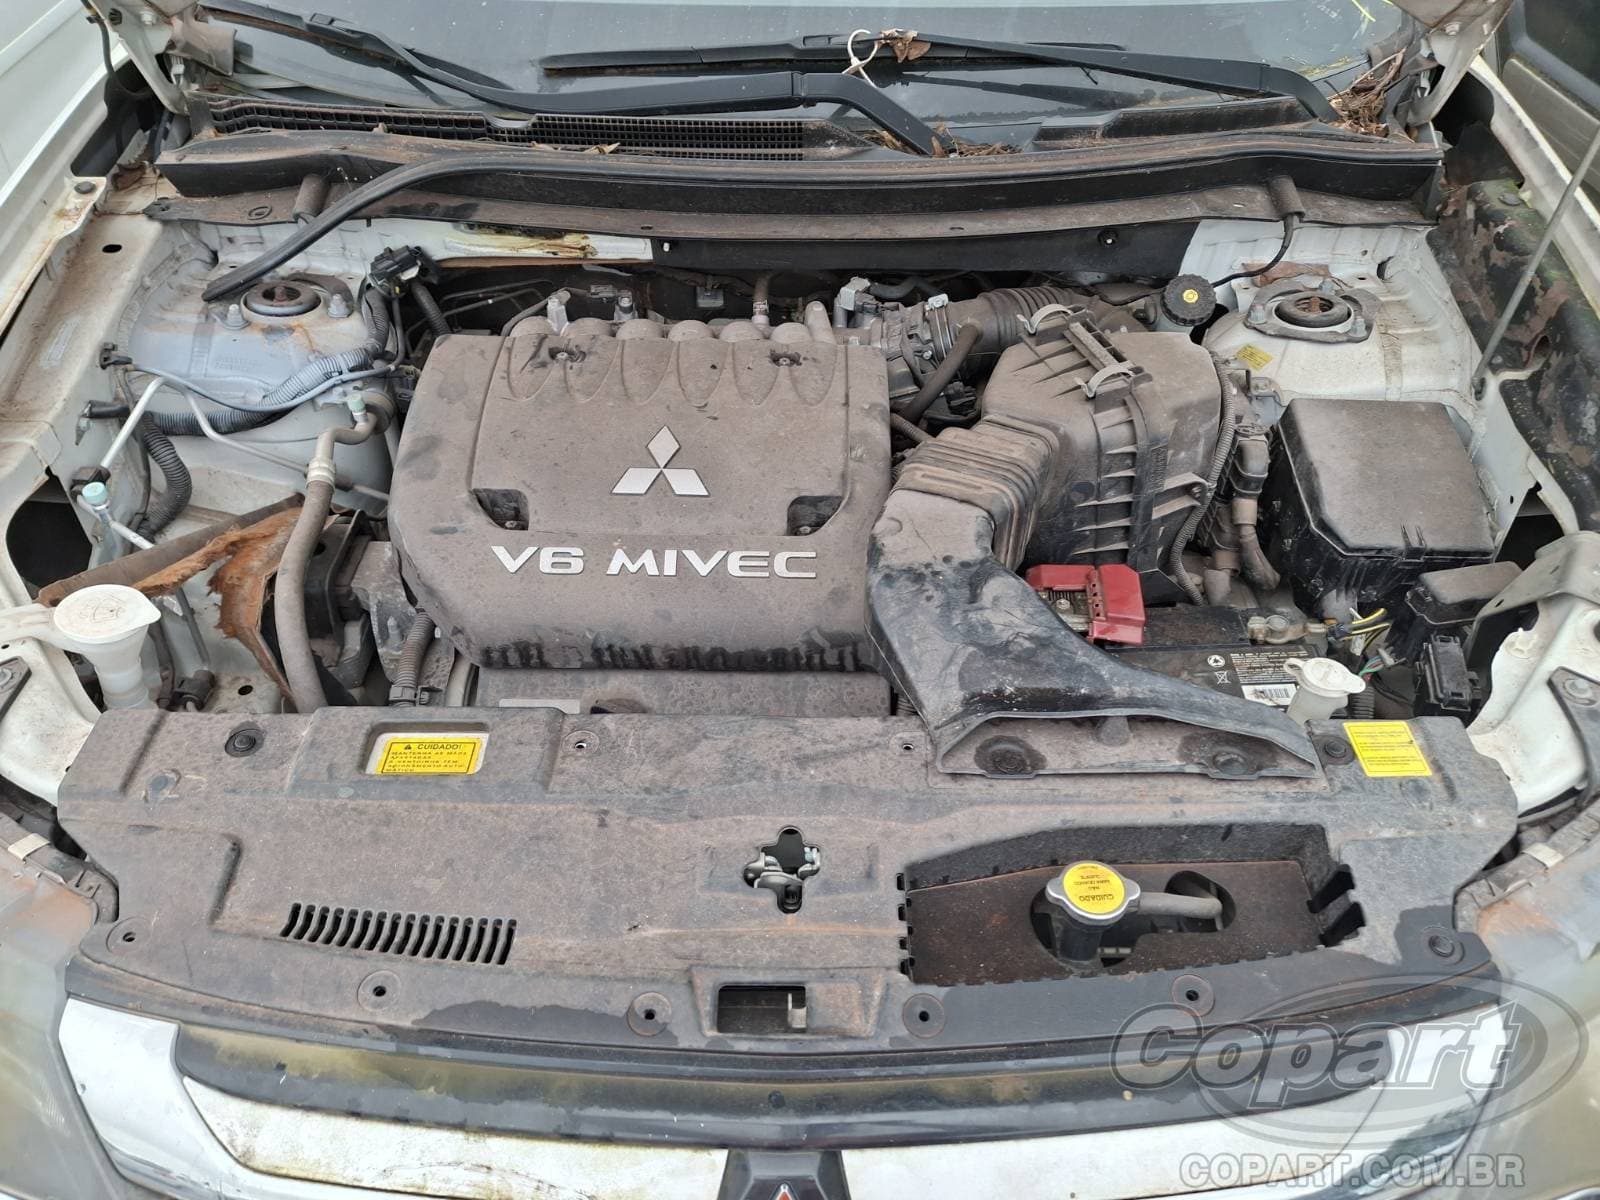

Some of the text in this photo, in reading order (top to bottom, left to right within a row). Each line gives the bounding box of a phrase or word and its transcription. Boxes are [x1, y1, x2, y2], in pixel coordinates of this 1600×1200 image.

[491, 545, 818, 579] V6 MIVEC
[1079, 894, 1114, 902] CUIDADO
